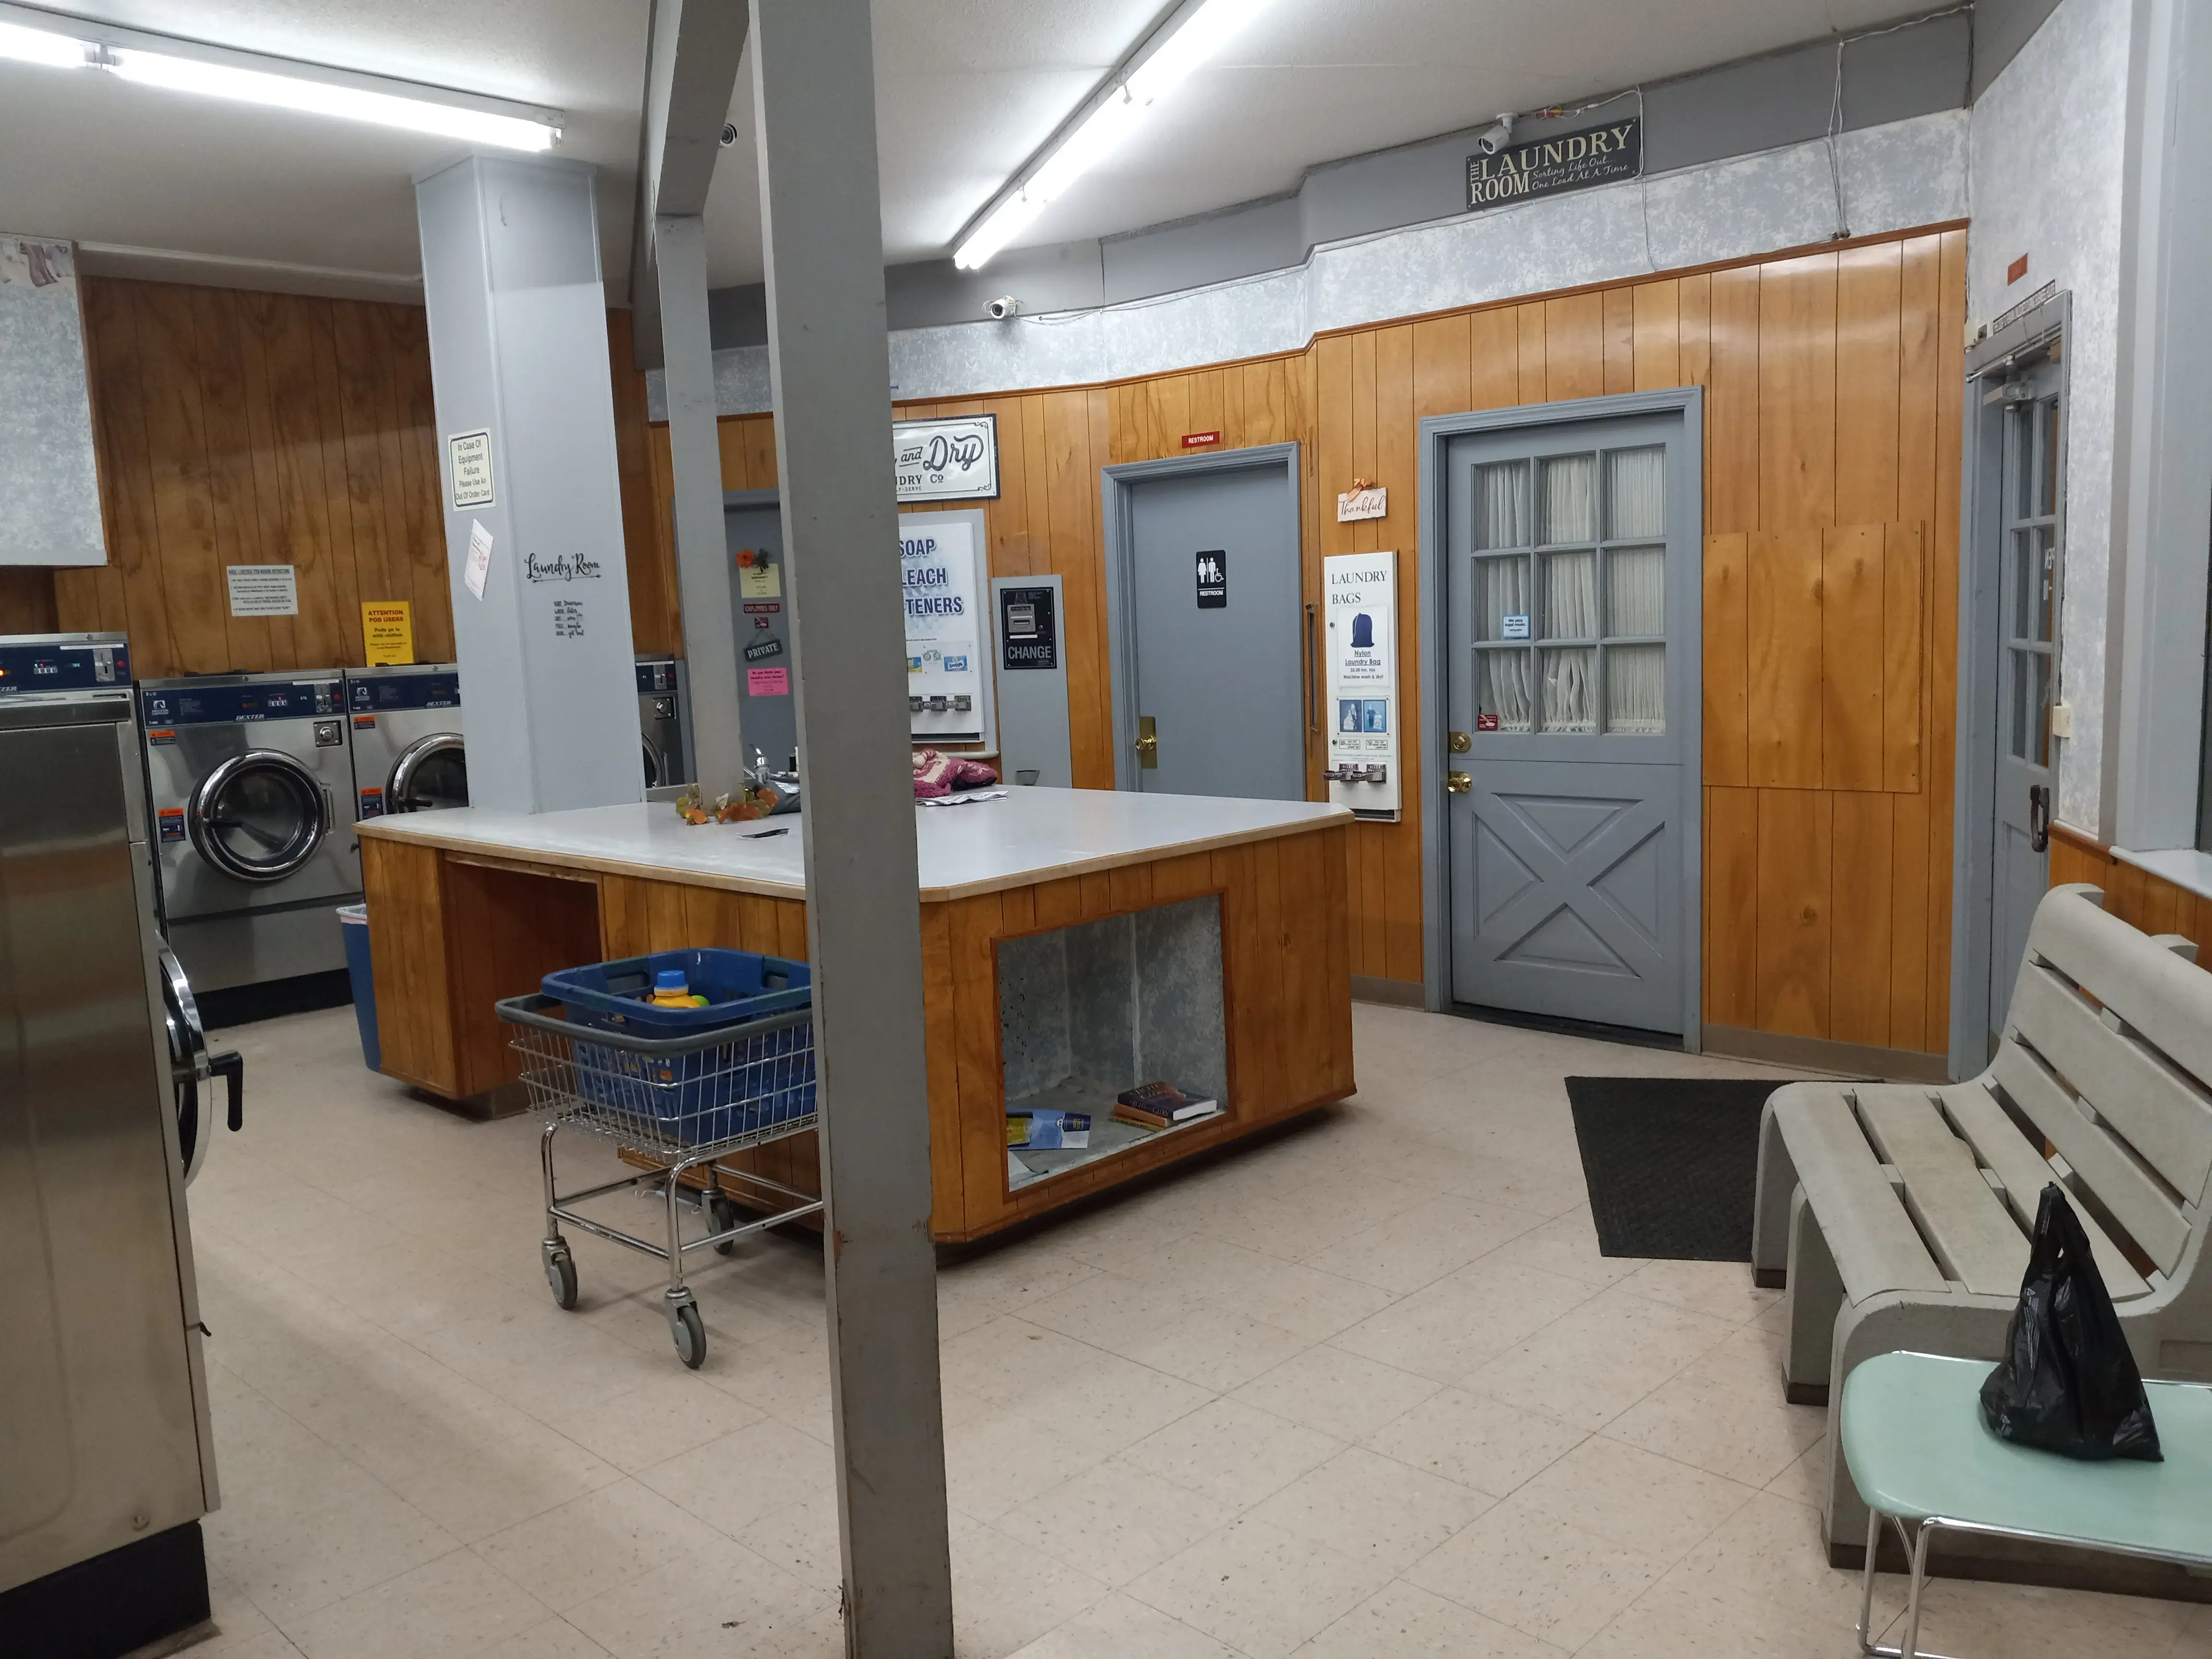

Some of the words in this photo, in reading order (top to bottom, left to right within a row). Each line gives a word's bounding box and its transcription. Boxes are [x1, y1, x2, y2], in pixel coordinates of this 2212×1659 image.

[1470, 160, 1479, 183] THE
[1480, 124, 1633, 180] LAUNDRY
[1532, 167, 1564, 179] Sorting
[1568, 159, 1587, 172] Life
[1532, 181, 1549, 190] One
[1551, 174, 1575, 186] Load
[1575, 170, 1590, 181] At
[1591, 168, 1601, 179] A
[1603, 165, 1629, 174] Time
[1471, 171, 1530, 204] ROOM
[457, 443, 462, 451] In
[463, 441, 475, 450] Case
[475, 439, 481, 448] Of
[1188, 434, 1214, 444] RESTROOM
[458, 452, 483, 465] Equipment
[901, 446, 923, 462] and
[923, 434, 984, 471] Dry
[463, 467, 480, 476] Failure
[1339, 495, 1385, 515] Thankful
[524, 553, 575, 582] Laundry
[571, 553, 601, 575] Room
[1332, 570, 1387, 584] LAUNDRY
[905, 597, 962, 614] TENERS
[1332, 592, 1361, 604] BAGS
[747, 643, 779, 659] PRIVATE
[1008, 646, 1051, 659] CHANGE
